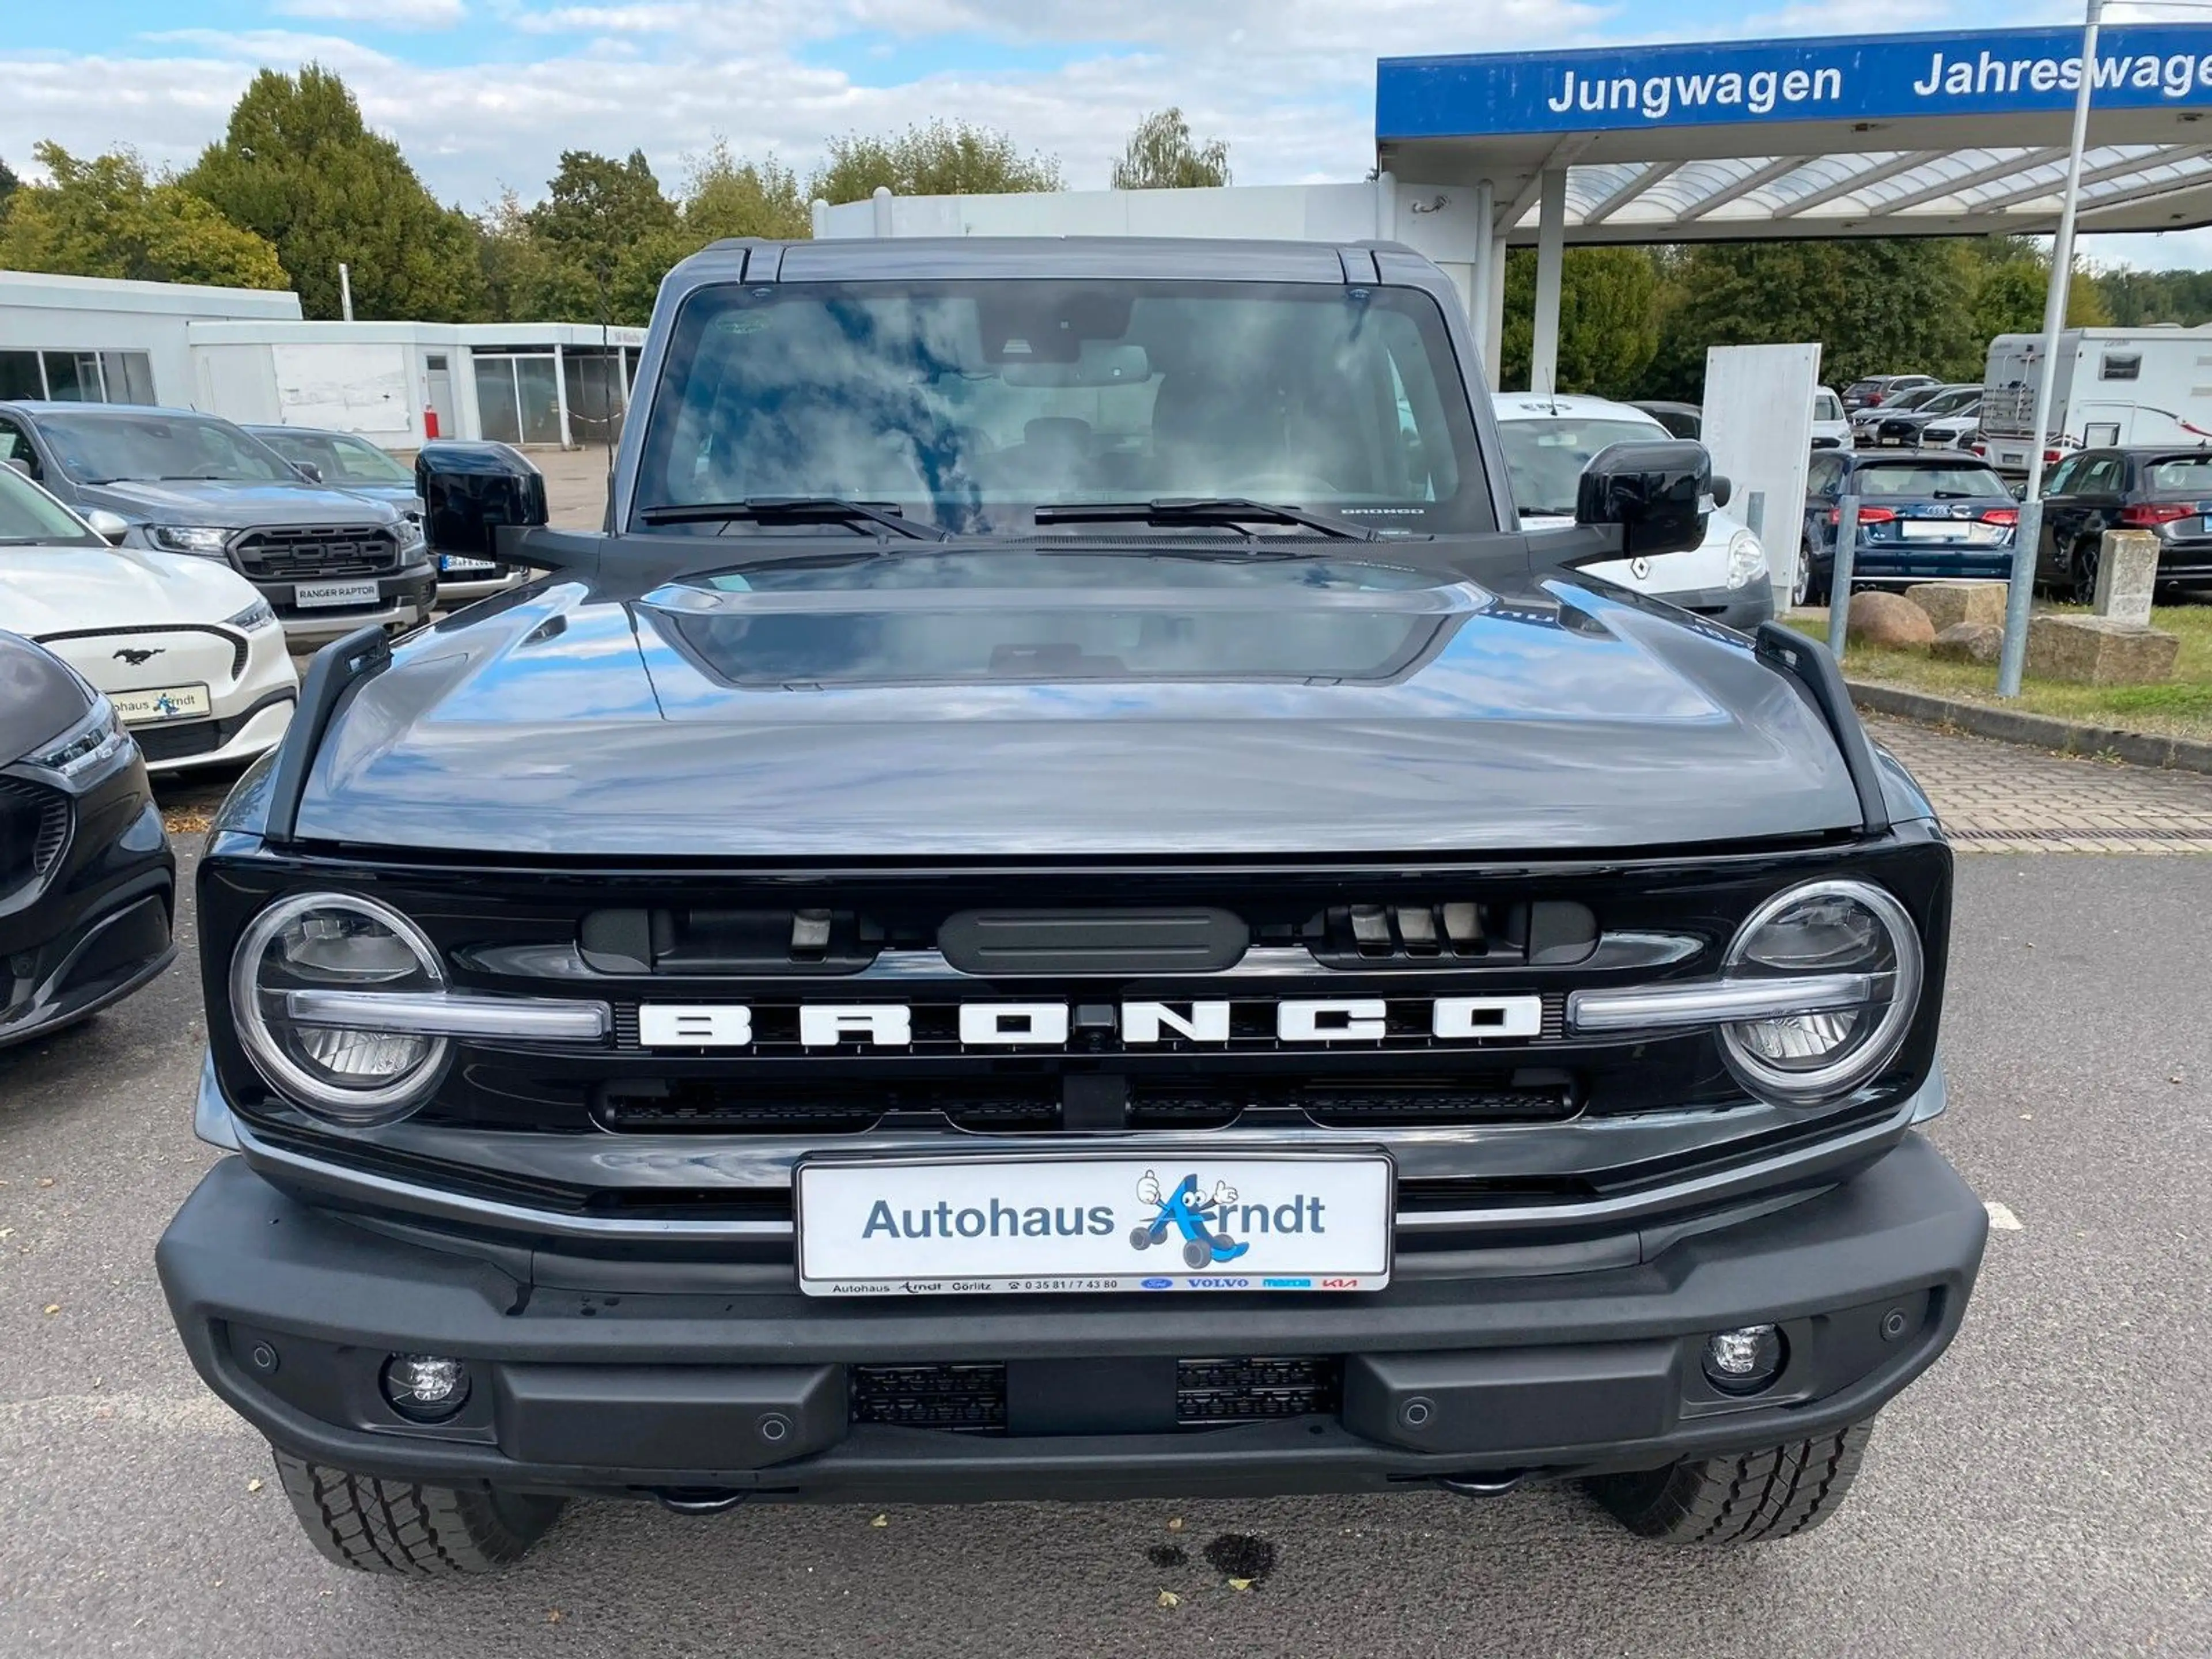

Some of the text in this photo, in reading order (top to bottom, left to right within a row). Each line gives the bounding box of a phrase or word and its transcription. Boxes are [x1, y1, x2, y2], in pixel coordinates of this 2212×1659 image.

[1548, 67, 1842, 119] Jungwagen
[236, 540, 396, 562] FORD
[300, 585, 375, 599] RANGER RAPTOR
[639, 995, 1543, 1046] BRONCO
[862, 1198, 1115, 1238] Autohaus
[832, 1283, 890, 1293] Autohaus
[1188, 1278, 1249, 1288] VOLVO
